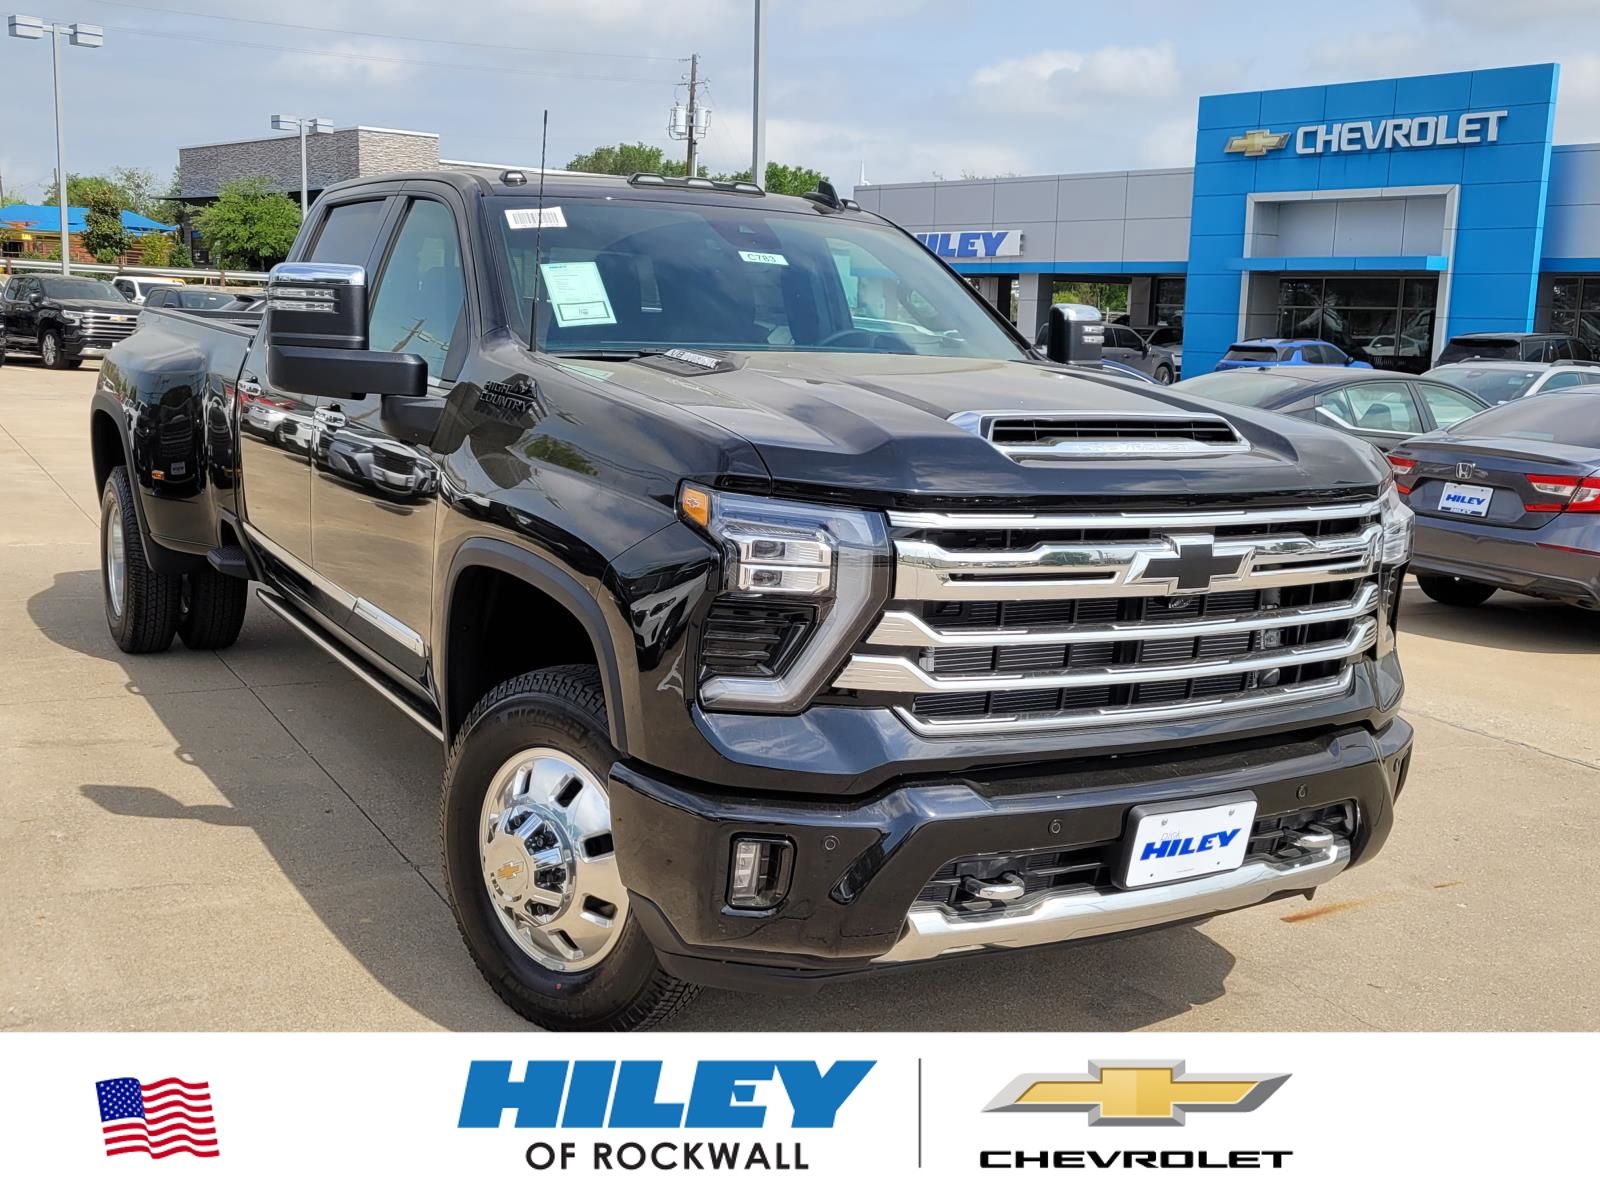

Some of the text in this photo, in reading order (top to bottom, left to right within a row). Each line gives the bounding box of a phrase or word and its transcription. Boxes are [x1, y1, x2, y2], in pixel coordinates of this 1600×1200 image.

[1296, 110, 1508, 154] CHEVROLET
[480, 390, 530, 412] COUNTRY
[1445, 494, 1486, 506] HILEY
[1140, 828, 1242, 861] HILEY
